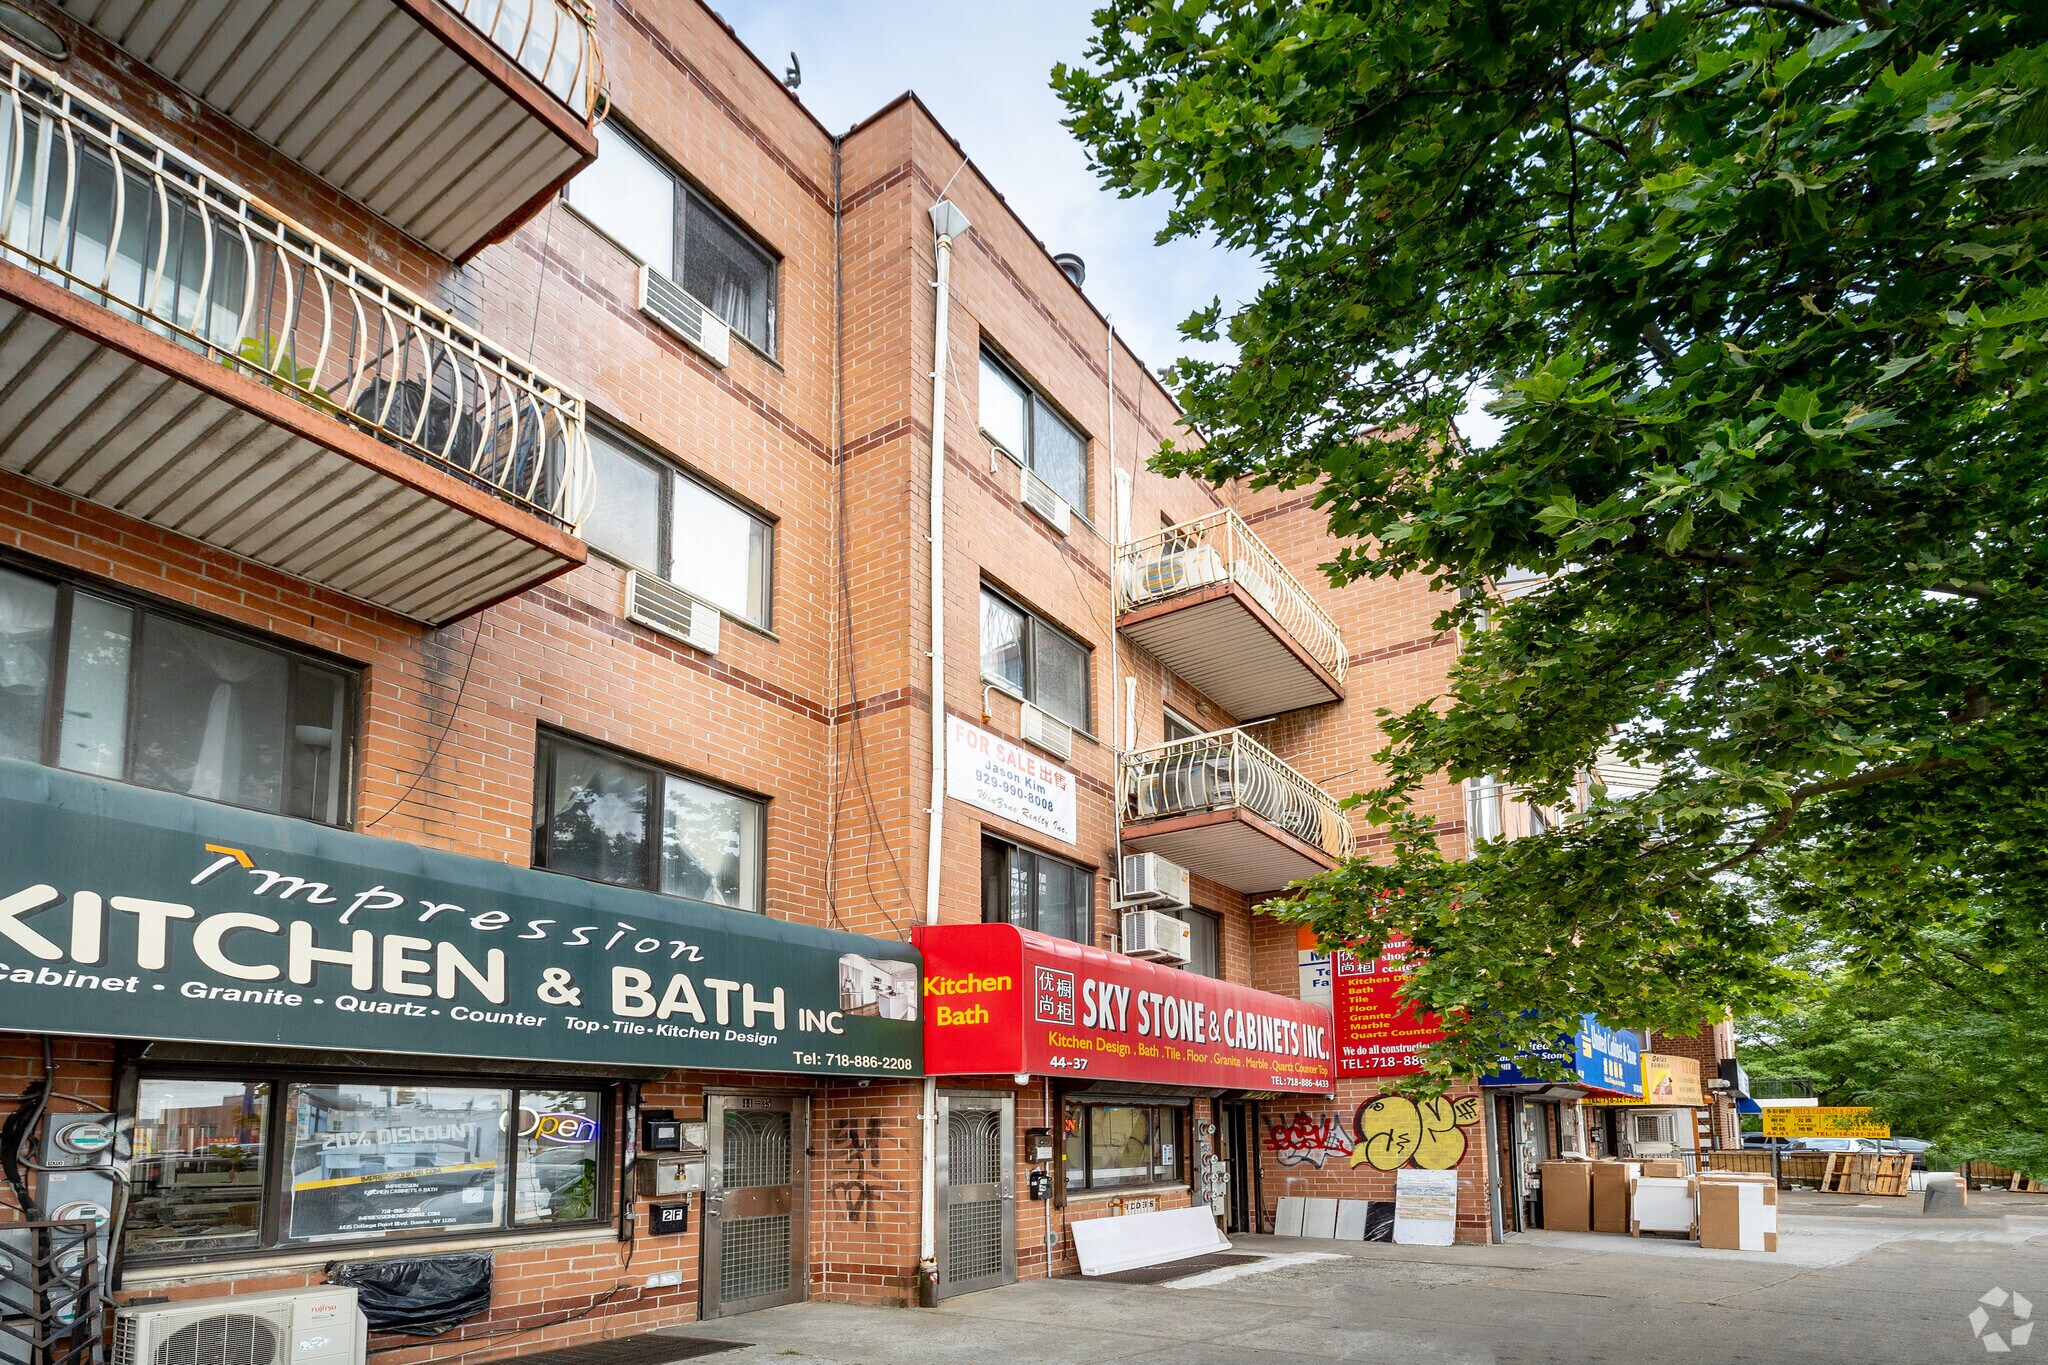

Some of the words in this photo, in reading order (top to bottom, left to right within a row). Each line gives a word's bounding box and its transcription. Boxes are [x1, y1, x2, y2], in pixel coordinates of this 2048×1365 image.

[955, 723, 989, 756] FOR
[996, 743, 1035, 777] SALE
[985, 760, 1020, 784] Jason
[1025, 776, 1046, 795] Kim
[1039, 764, 1067, 791] 出售
[975, 769, 1054, 812] 929-990-8008
[1022, 807, 1049, 828] Realty
[190, 843, 705, 962] Impression
[0, 884, 505, 1005] KITCHEN
[537, 966, 582, 1007] &
[611, 965, 786, 1031] BATH
[798, 1008, 844, 1035] INC
[1316, 968, 1331, 976] Te
[1348, 975, 1390, 986] Kitchen
[924, 971, 1012, 997] Kitchen
[1312, 979, 1331, 987] Fa
[1348, 986, 1374, 995] Bath
[180, 981, 304, 1007] Granite
[335, 995, 426, 1018] Quartz
[449, 1006, 547, 1028] Counter
[565, 1016, 600, 1034] Top
[612, 1020, 645, 1035] Tile
[656, 1024, 720, 1041] Kitchen
[724, 1030, 778, 1047] Design
[936, 1005, 989, 1027] Bath
[1349, 1004, 1378, 1012] Floor
[1349, 1012, 1392, 1021] Granite
[1082, 978, 1131, 1032] SKY
[1137, 990, 1206, 1043] STONE
[1209, 1010, 1221, 1042] &
[1224, 1008, 1299, 1056] CABINETS
[1303, 1024, 1330, 1060] INC.
[1350, 1021, 1390, 1030] Marble
[1350, 1031, 1388, 1040] Quartz
[1391, 1028, 1438, 1037] Counter
[792, 1051, 822, 1066] Tel:
[825, 1053, 913, 1070] 718-886-2208
[1049, 1031, 1093, 1050] Kitchen
[1096, 1037, 1131, 1057] Design
[1138, 1043, 1159, 1058] Bath
[1164, 1046, 1181, 1060] Tile
[1187, 1049, 1207, 1063] Floor
[1213, 1053, 1241, 1067] Granite
[1245, 1057, 1268, 1069] Marble
[1272, 1060, 1294, 1073] Quartz
[1295, 1062, 1318, 1075] Counter
[1318, 1065, 1328, 1077] Top
[1342, 1046, 1356, 1056] We
[1357, 1046, 1367, 1055] do
[1368, 1044, 1380, 1055] all
[1049, 1056, 1088, 1071] 44-37
[1271, 1075, 1330, 1088] TEL:718-886-4433
[499, 1106, 596, 1139] Open
[321, 1130, 372, 1150] 20%
[376, 1122, 477, 1145] DISCOUNT
[663, 1209, 682, 1220] 2F
